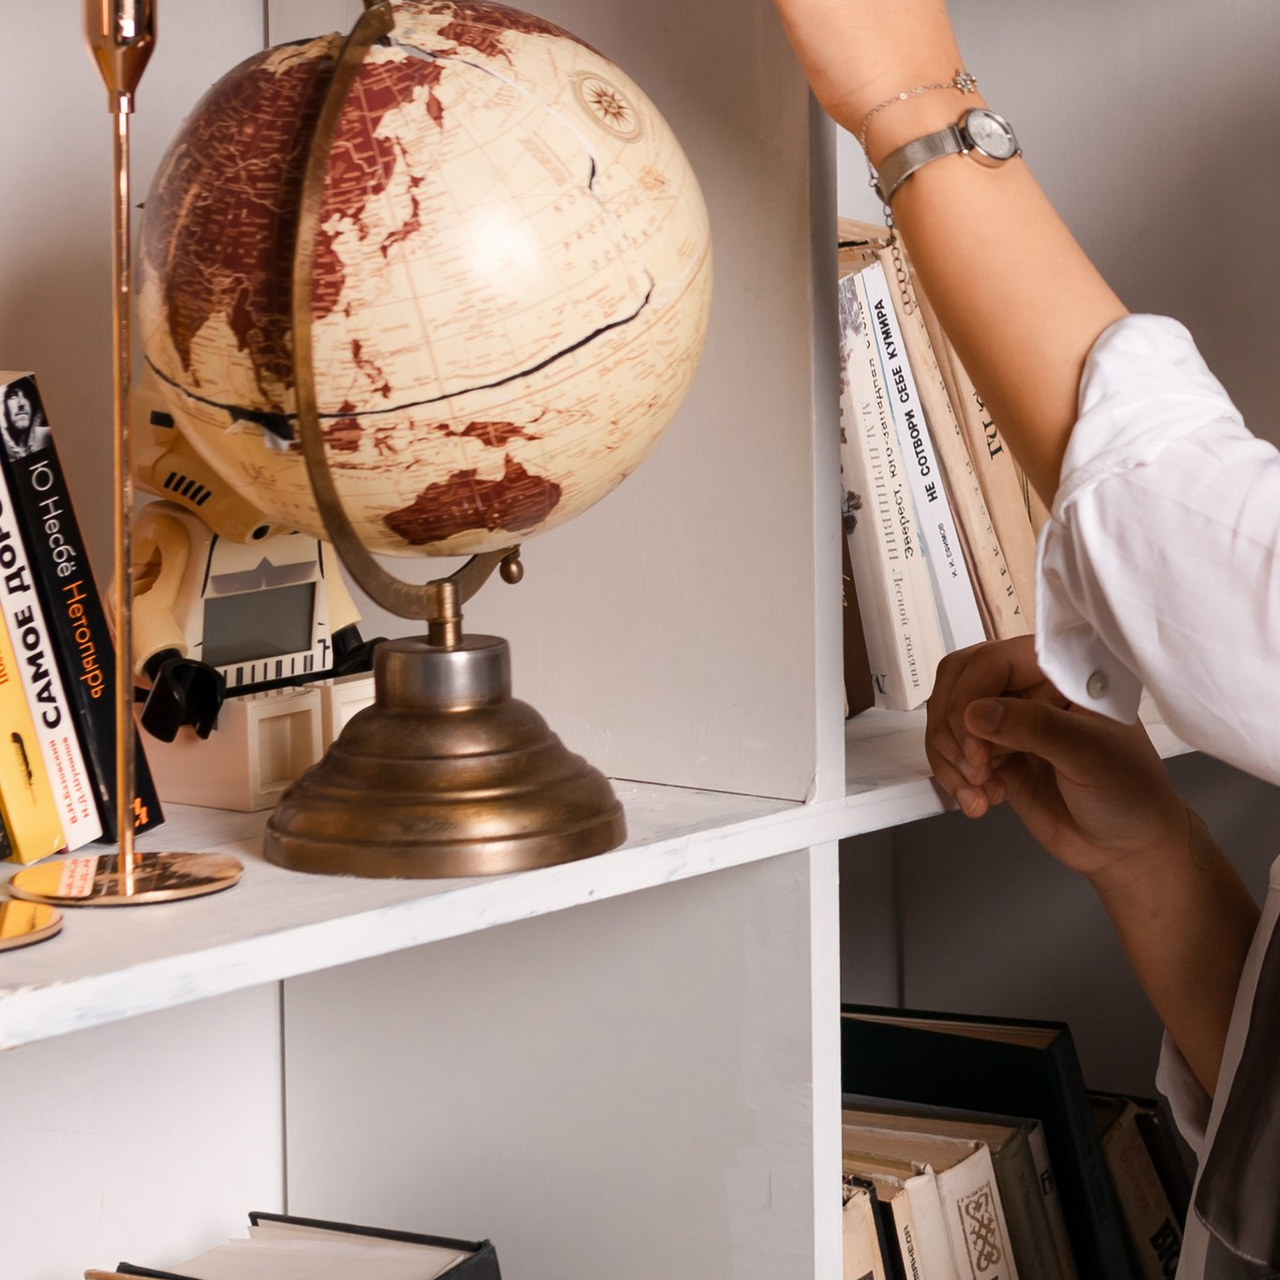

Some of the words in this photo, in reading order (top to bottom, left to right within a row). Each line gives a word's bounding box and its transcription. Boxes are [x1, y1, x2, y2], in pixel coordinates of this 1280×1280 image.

[873, 298, 898, 360] КУМИРА
[894, 364, 910, 403] СЕБЕ
[28, 460, 55, 492] Ю
[904, 408, 931, 480] СОТВОРИ
[923, 483, 939, 504] НЕ
[38, 495, 77, 579] Несбё
[14, 604, 62, 730] САМОЕ
[62, 580, 105, 700] Нетопырь
